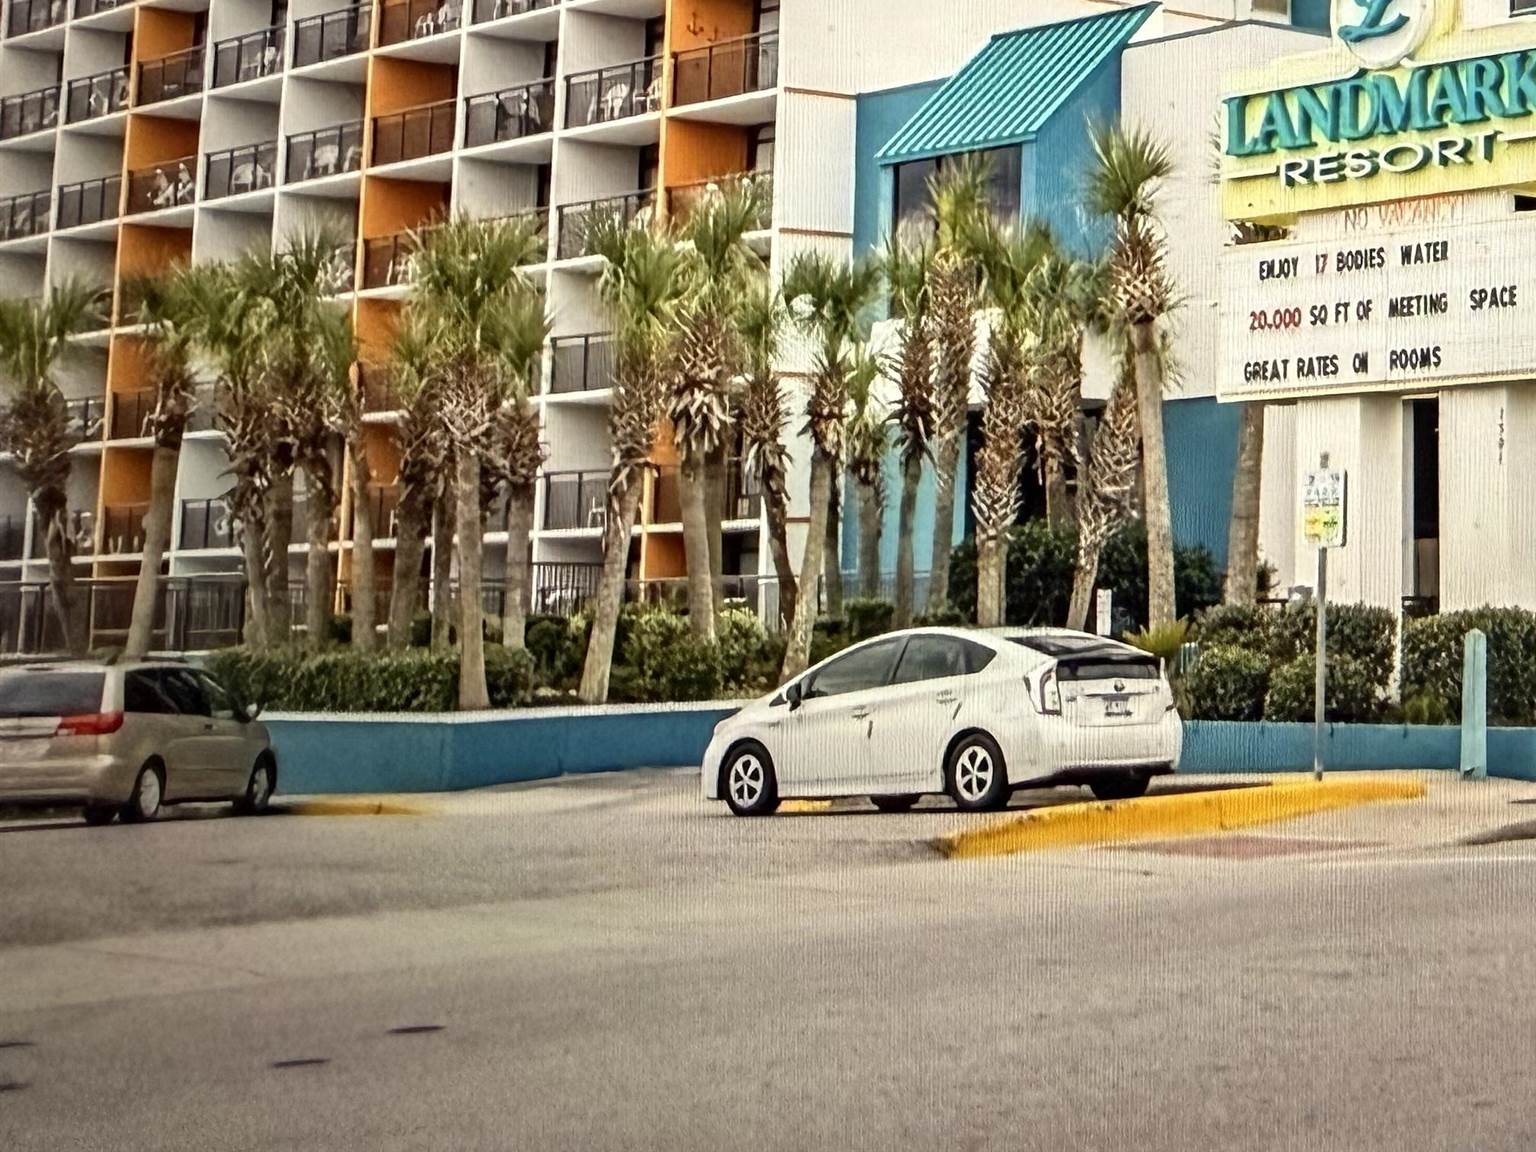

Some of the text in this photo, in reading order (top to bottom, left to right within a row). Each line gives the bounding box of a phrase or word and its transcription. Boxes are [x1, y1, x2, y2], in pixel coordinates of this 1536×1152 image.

[1280, 132, 1499, 188] RESORT
[1258, 240, 1449, 281] ENJOY 17 BODIES WATER
[1310, 303, 1328, 327] SQ
[1334, 301, 1351, 323] FT
[1356, 298, 1373, 320] OF
[1388, 291, 1449, 318] MEETING
[1469, 284, 1518, 311] SPACE
[1243, 344, 1442, 383] GREAT RATES ON ROOMS
